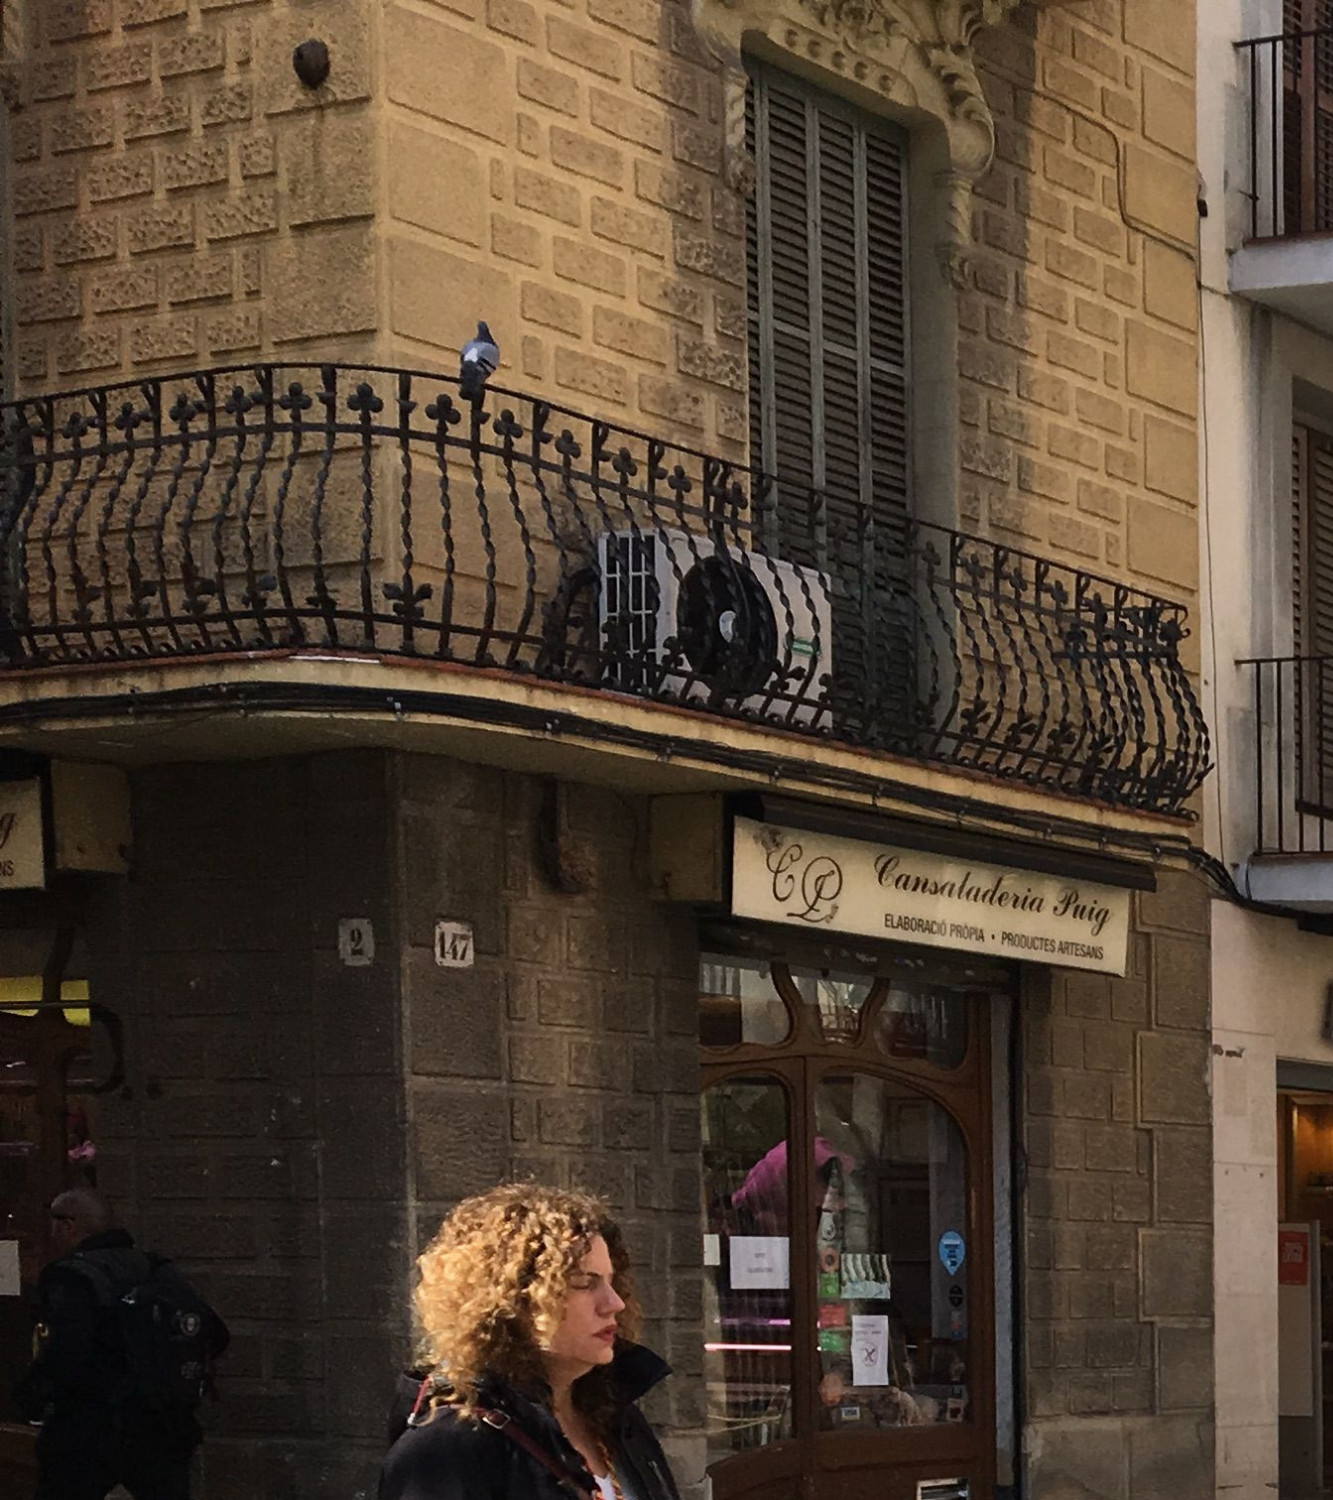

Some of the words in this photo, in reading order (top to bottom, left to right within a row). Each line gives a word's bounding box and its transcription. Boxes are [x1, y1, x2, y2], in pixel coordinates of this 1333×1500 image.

[874, 852, 1054, 914] Cansaladeria
[1053, 886, 1112, 937] Puig
[351, 928, 363, 956] 2
[439, 931, 472, 960] 147
[884, 912, 948, 938] ELABORACIÓ
[949, 920, 985, 943] PRÒPIA
[1001, 931, 1057, 953] PRODUCTES
[1057, 939, 1105, 961] ARTESANS
